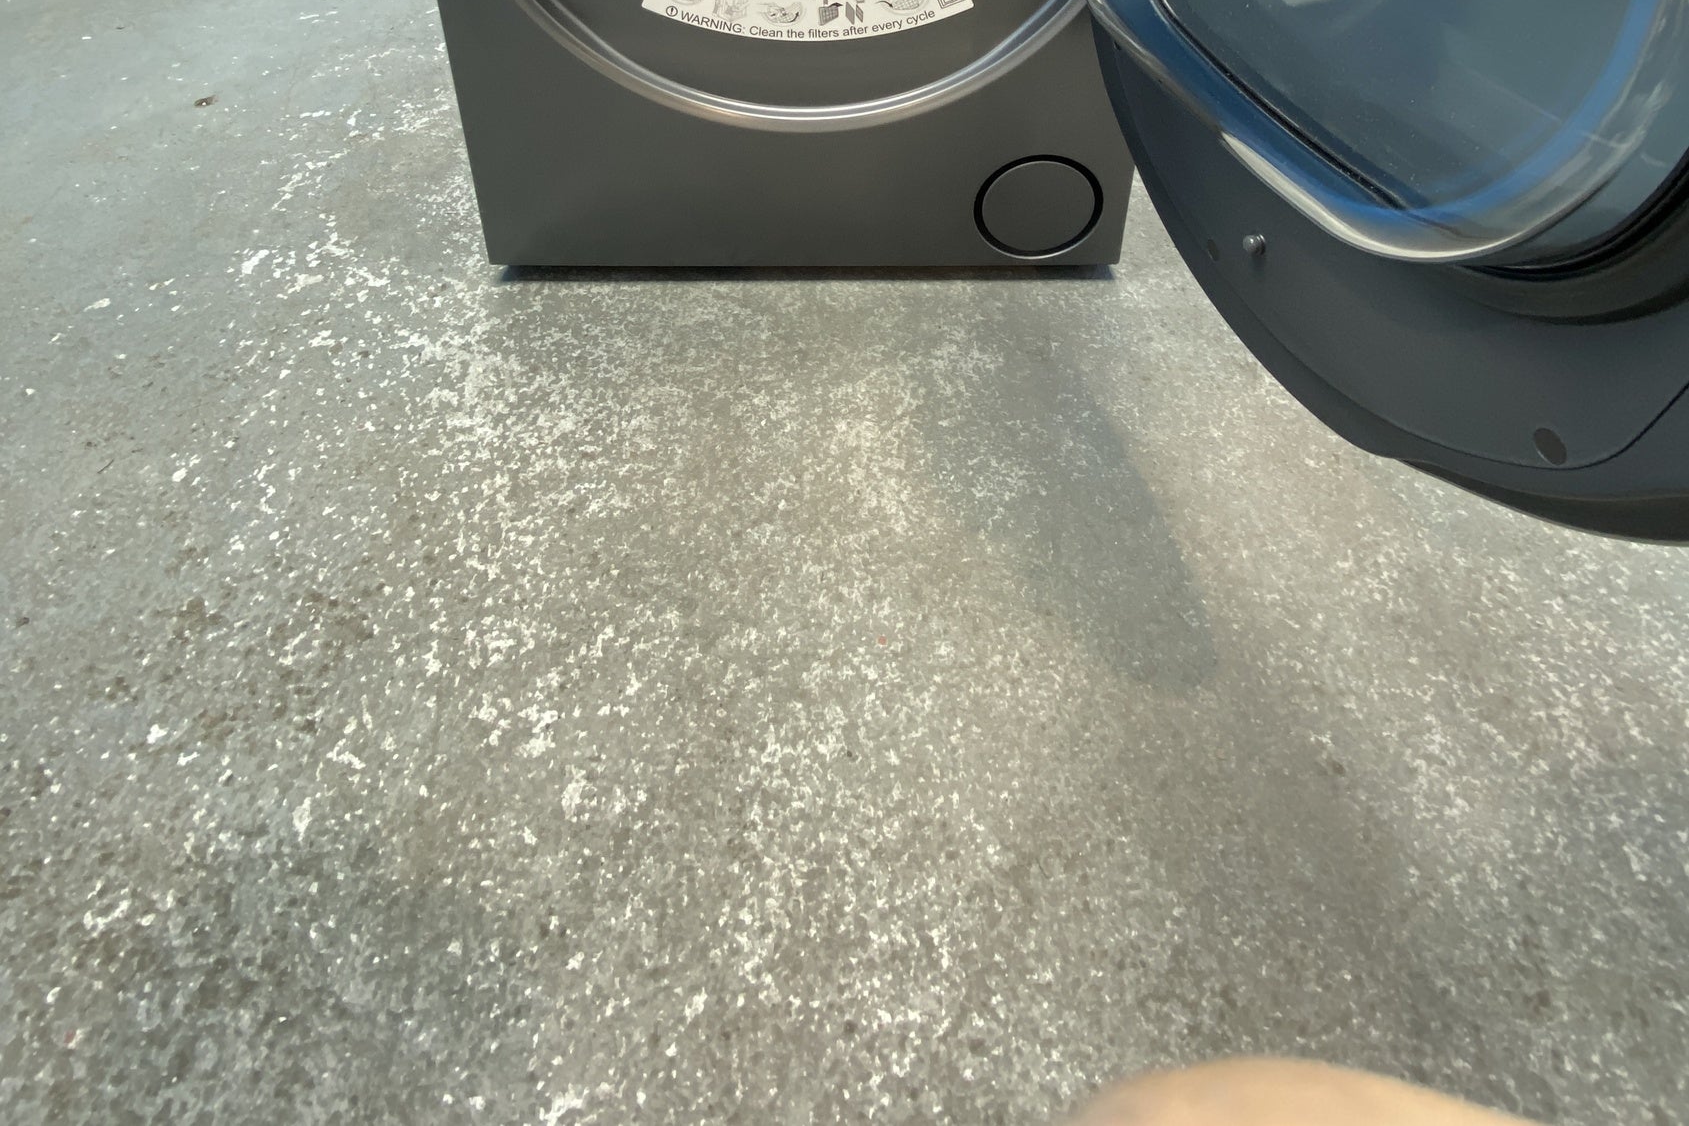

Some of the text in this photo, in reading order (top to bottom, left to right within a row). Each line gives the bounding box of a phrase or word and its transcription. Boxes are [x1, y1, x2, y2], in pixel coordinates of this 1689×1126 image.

[681, 8, 936, 39] WARNING: Clean the filters after every cycle
